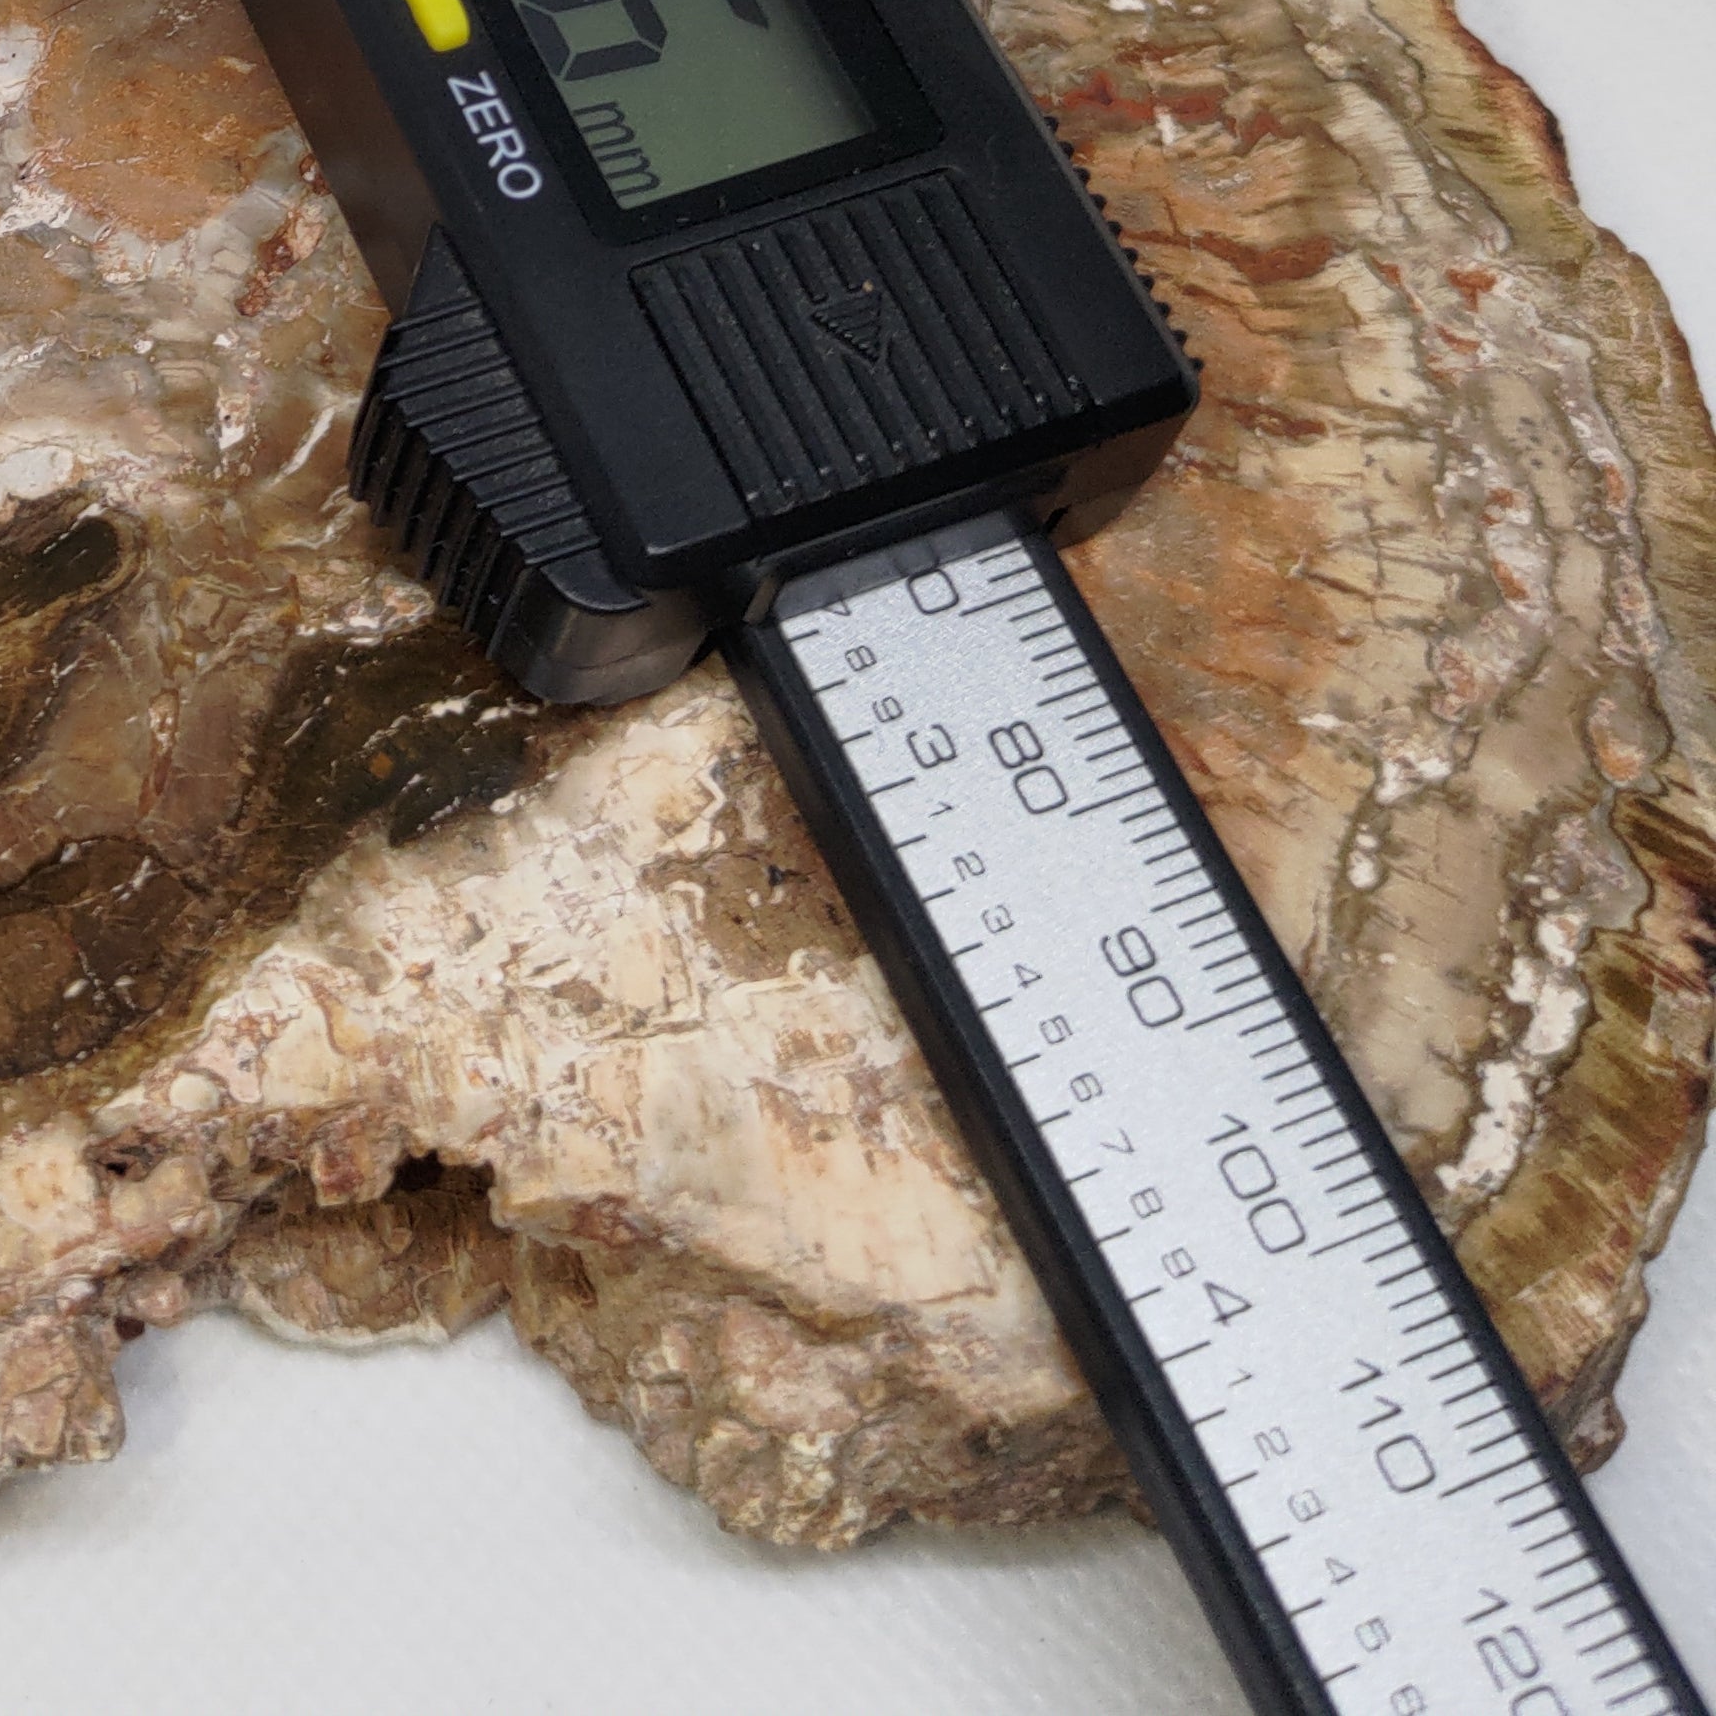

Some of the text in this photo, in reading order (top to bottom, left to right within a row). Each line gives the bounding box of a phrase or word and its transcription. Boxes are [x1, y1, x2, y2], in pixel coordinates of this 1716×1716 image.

[447, 70, 543, 200] ZERO
[572, 101, 662, 198] mm
[844, 645, 877, 672] 8
[872, 696, 904, 723] 9
[906, 724, 958, 770] 3
[929, 800, 955, 819] 1
[953, 851, 986, 881] 2
[981, 905, 1014, 934] 3
[1014, 964, 1043, 989] 4
[1039, 1015, 1073, 1045] 5
[1070, 1072, 1103, 1103] 6
[988, 720, 1069, 815] 80
[1100, 925, 1185, 1029] 90
[1206, 1114, 1307, 1254] 100
[1339, 1357, 1437, 1494] 110
[1100, 1130, 1135, 1155] 7
[1130, 1187, 1164, 1219] 8
[1162, 1247, 1197, 1279] 9
[1204, 1282, 1252, 1326] 4
[1227, 1366, 1254, 1388] 1
[1254, 1426, 1292, 1461] 2
[1288, 1490, 1326, 1523] 3
[1326, 1558, 1357, 1585] 4
[1355, 1616, 1391, 1653] 5
